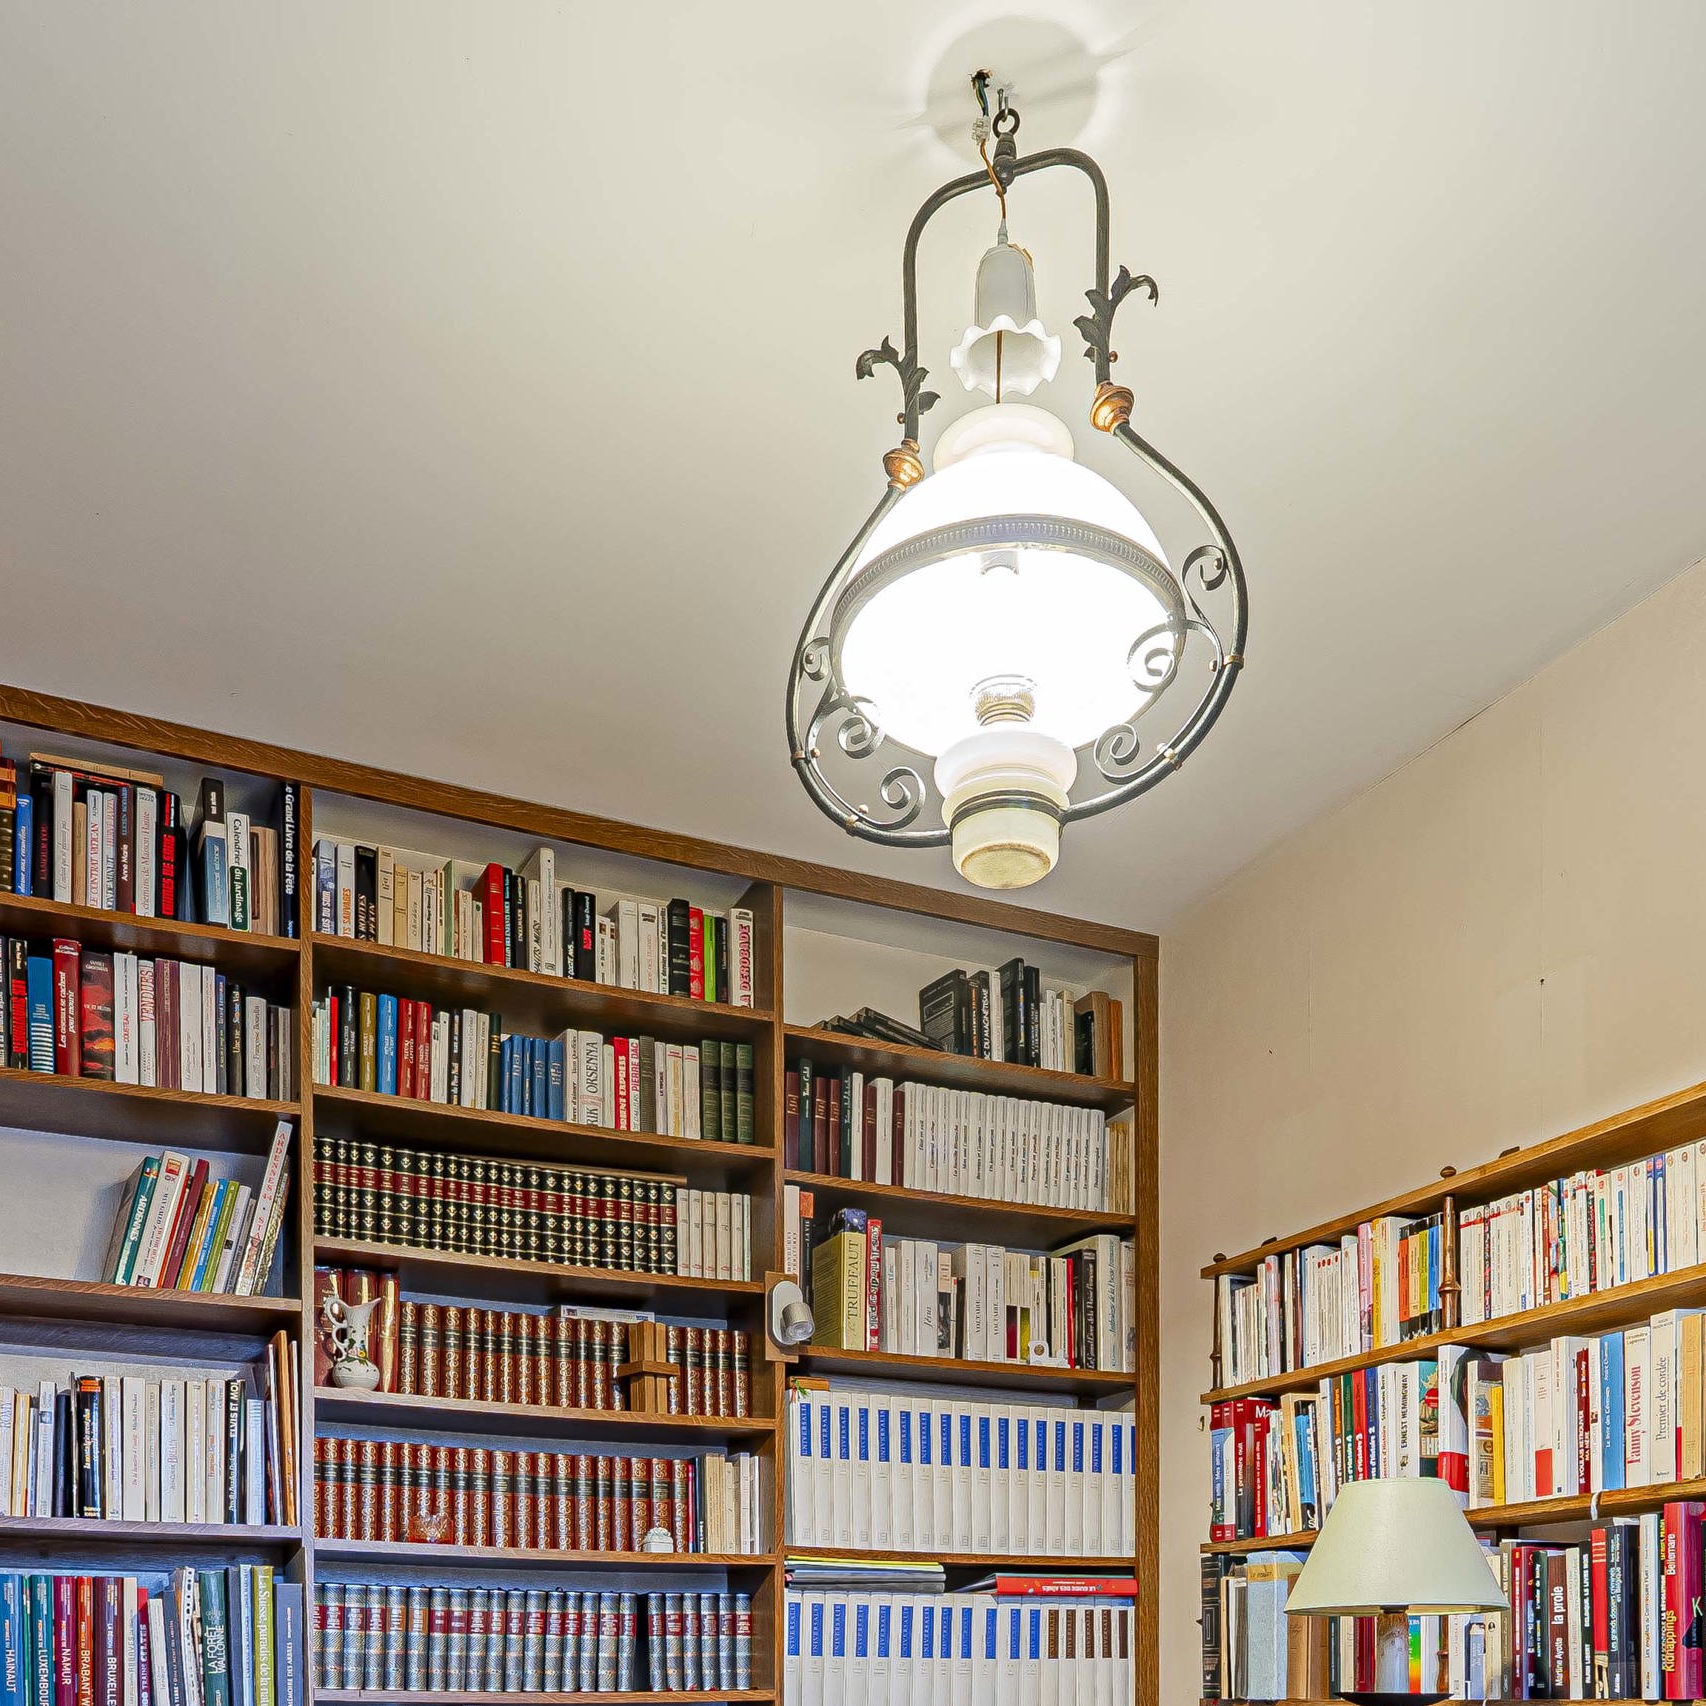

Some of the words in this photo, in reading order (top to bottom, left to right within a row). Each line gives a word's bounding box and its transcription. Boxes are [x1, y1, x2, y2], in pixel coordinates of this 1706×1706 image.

[233, 819, 242, 865] Calendrier
[90, 857, 98, 894] CONTRAT
[234, 869, 242, 879] du
[234, 881, 244, 923] jardinage
[343, 888, 351, 924] SAUVAGES
[59, 1008, 67, 1034] oiseaux
[68, 1016, 76, 1033] pour
[58, 1035, 67, 1048] Les
[631, 1061, 639, 1092] PIERRE
[847, 1240, 858, 1319] TRUFFAUT
[1656, 1357, 1666, 1388] cordée
[230, 1381, 239, 1400] MOI
[230, 1402, 238, 1410] ET
[1401, 1374, 1409, 1418] HEMINGWAY
[1627, 1366, 1641, 1427] Stevenson
[1657, 1390, 1666, 1401] de
[229, 1412, 238, 1438] ELVIS
[1656, 1403, 1668, 1440] Premier
[1627, 1430, 1646, 1464] Fanny
[1667, 1534, 1676, 1575] Bellemare
[1551, 1586, 1565, 1612] proie
[1551, 1614, 1563, 1625] la
[1555, 1638, 1563, 1659] Ayotte
[1665, 1610, 1676, 1671] Kidnappings
[6, 1649, 16, 1692] HAINAUT
[61, 1648, 71, 1685] NAMUR
[81, 1650, 90, 1695] BRABANT
[1555, 1660, 1563, 1686] Martine
